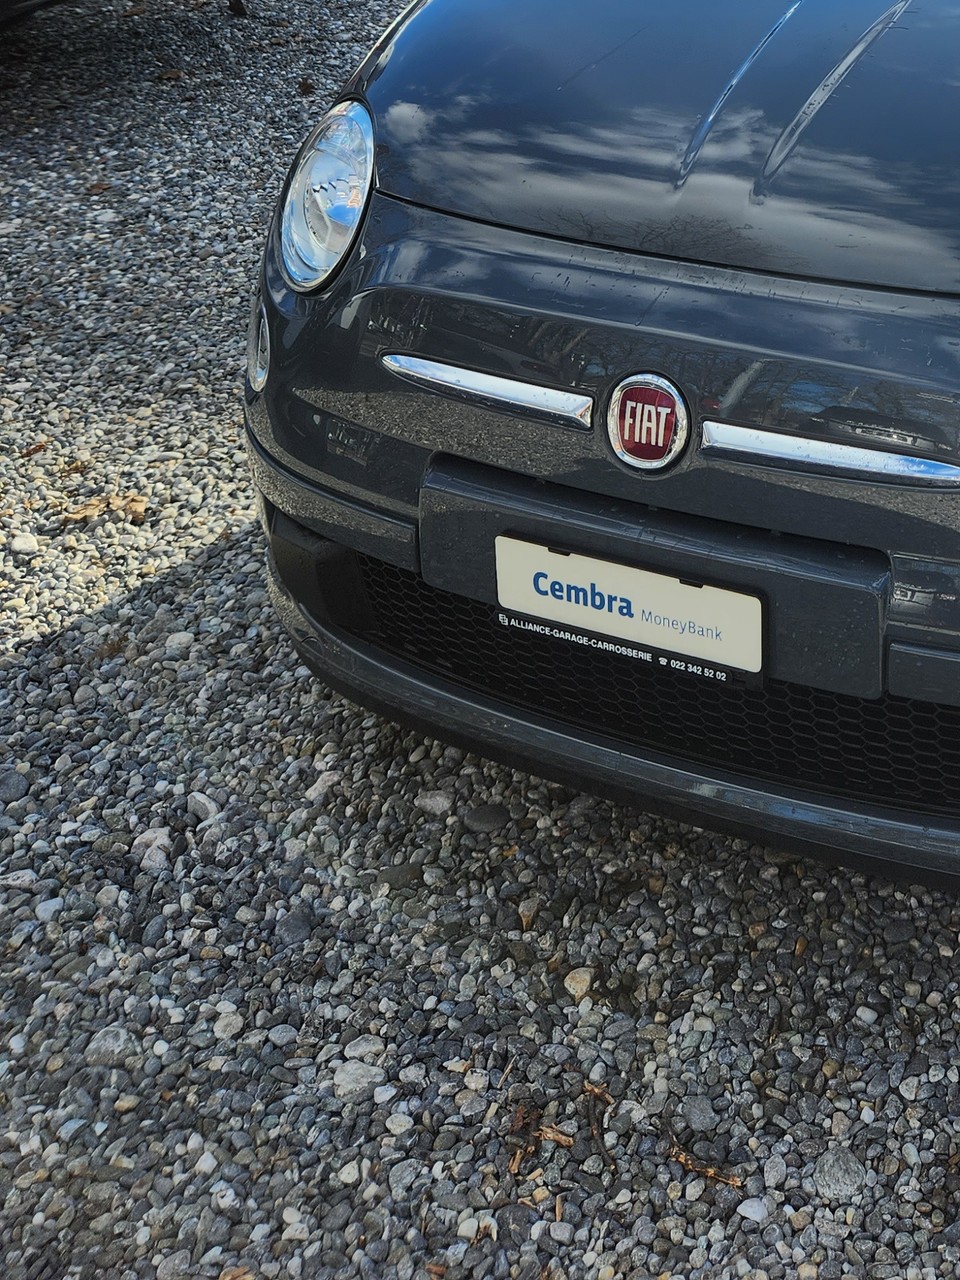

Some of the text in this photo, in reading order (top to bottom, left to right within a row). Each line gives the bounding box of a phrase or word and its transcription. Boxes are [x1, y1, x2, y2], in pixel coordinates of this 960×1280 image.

[624, 400, 671, 447] FIAT
[533, 572, 723, 641] Cembra MoneyBank
[510, 619, 727, 681] ALLIANCE-GARAGE-CARROSSERIE 022 342 52 02
